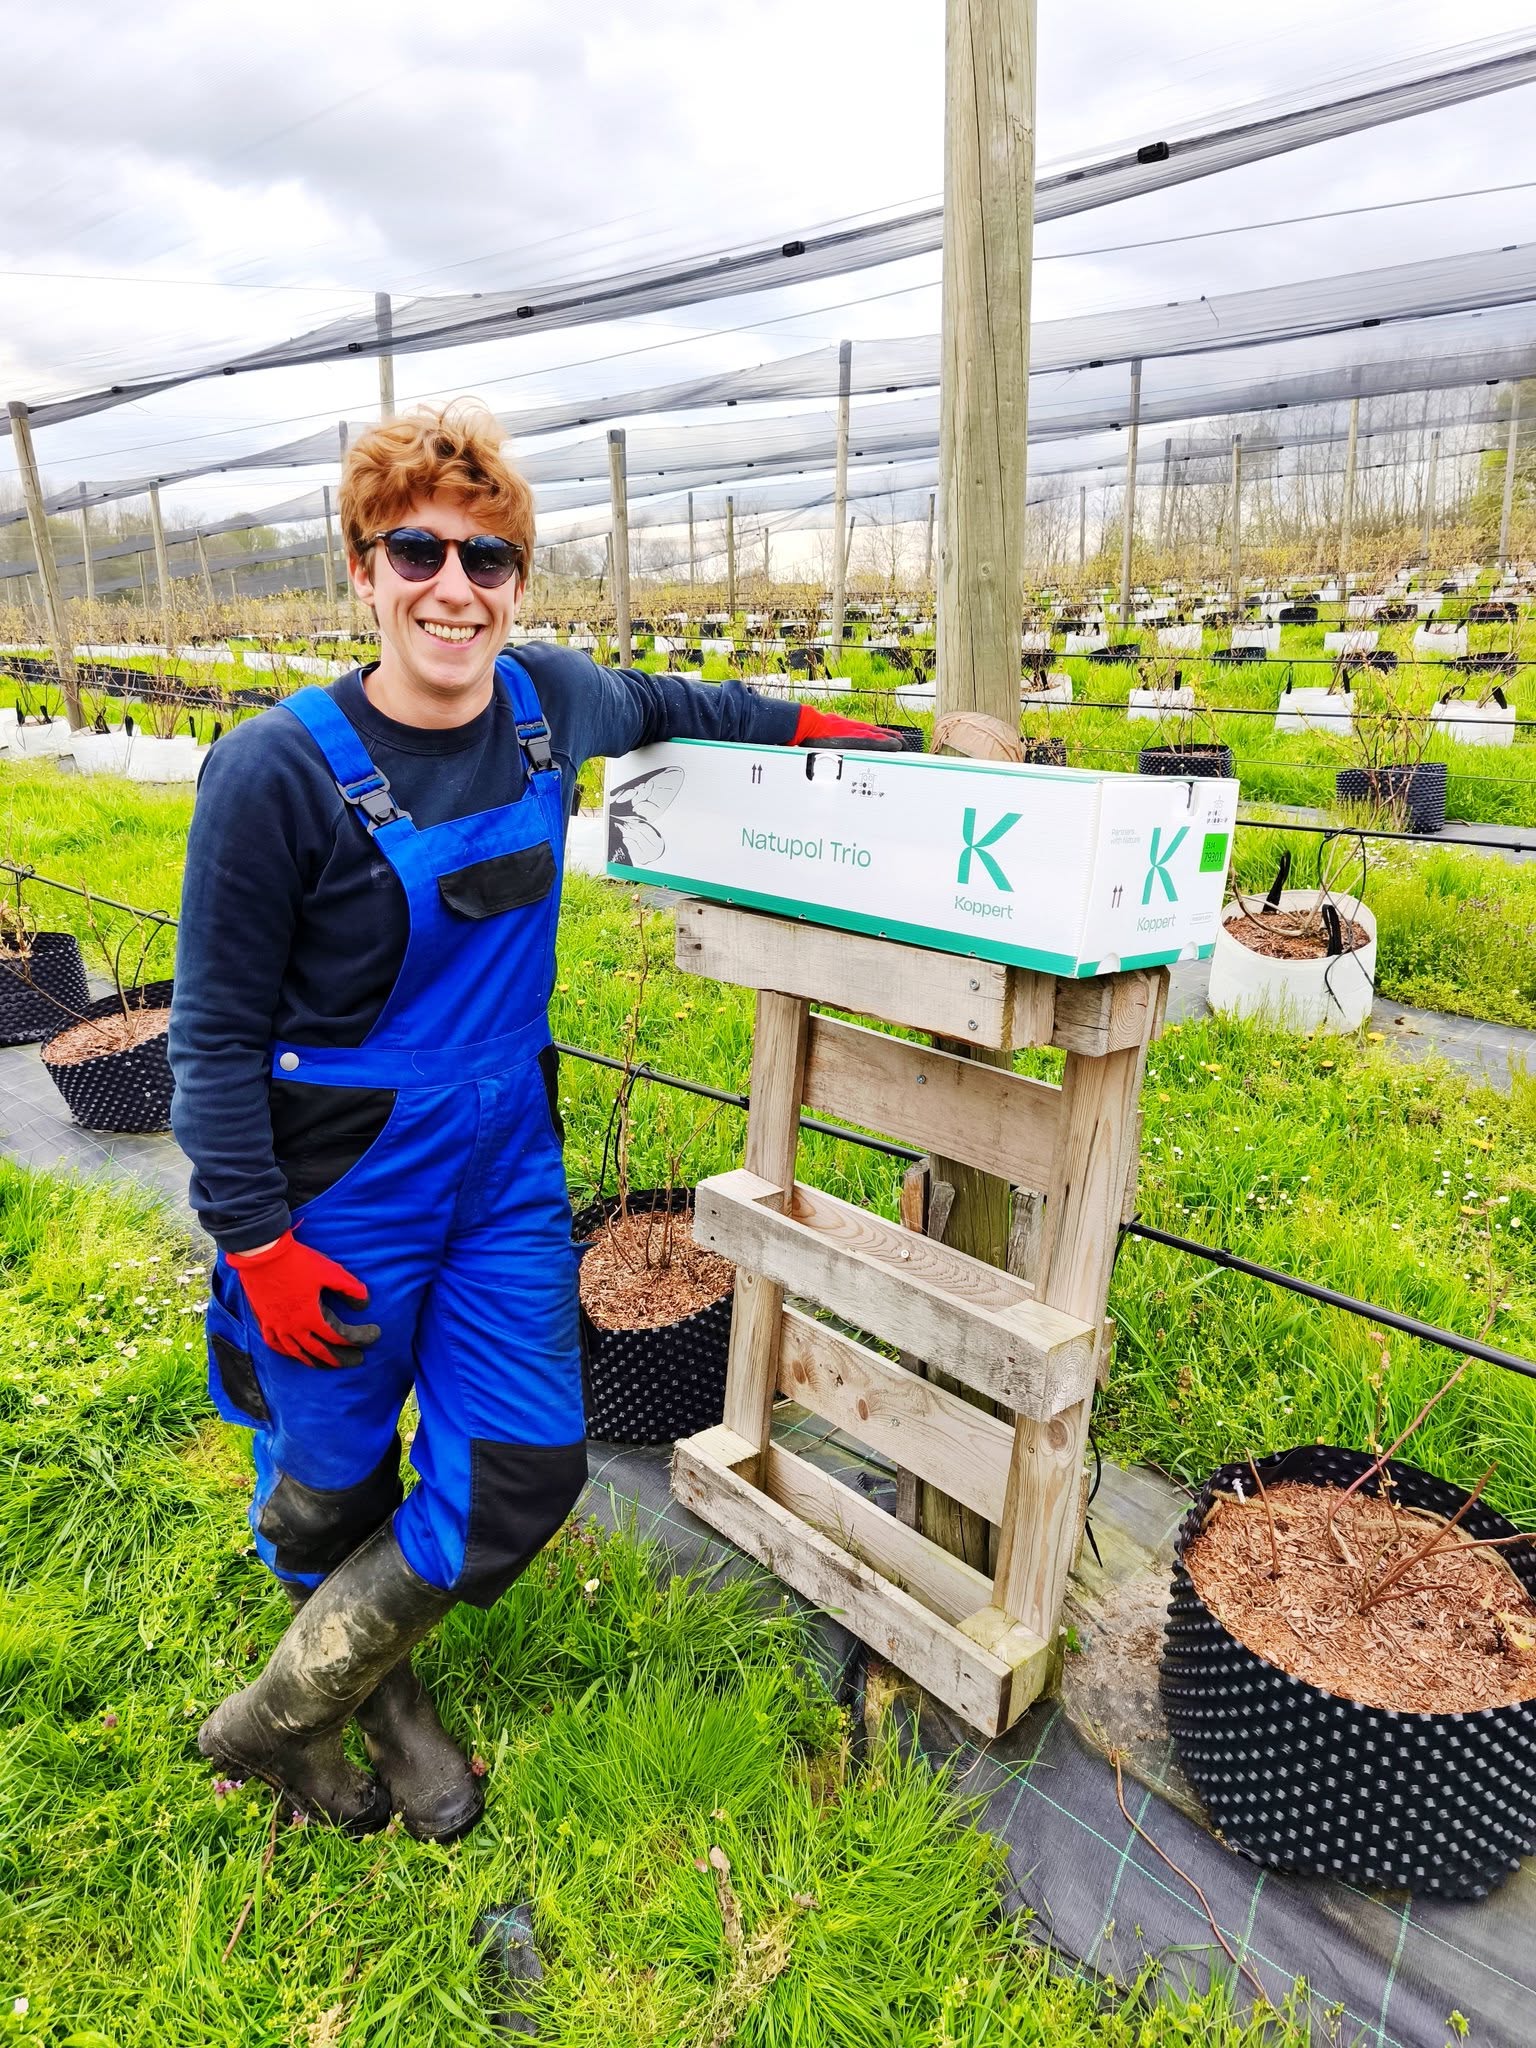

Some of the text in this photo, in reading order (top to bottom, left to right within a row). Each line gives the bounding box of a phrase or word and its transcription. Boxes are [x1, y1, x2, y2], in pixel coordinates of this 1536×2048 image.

[741, 827, 872, 868] Natupol Trio
[954, 895, 1014, 920] Koppert
[1136, 913, 1176, 932] Koppert
